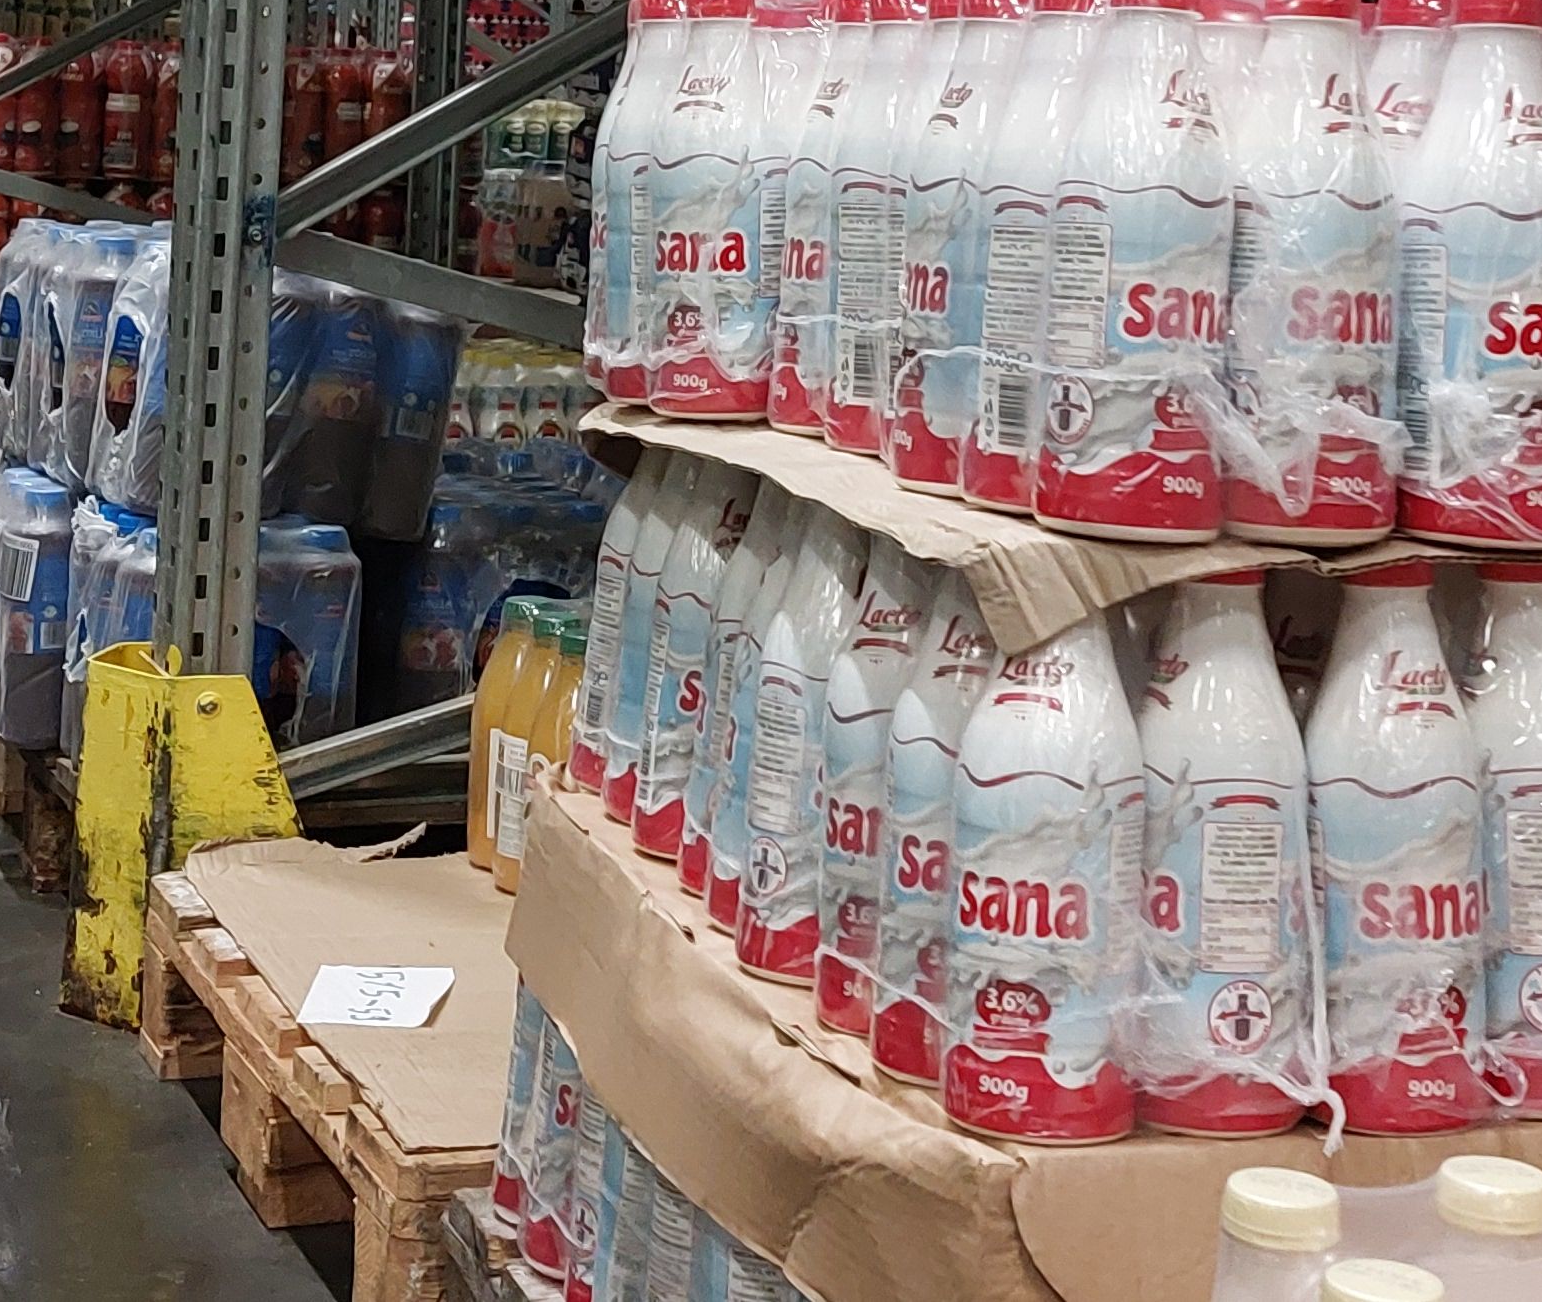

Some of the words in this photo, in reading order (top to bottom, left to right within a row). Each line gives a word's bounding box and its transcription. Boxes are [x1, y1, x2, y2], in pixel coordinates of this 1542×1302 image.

[781, 236, 826, 281] na
[905, 261, 950, 313] na
[672, 372, 708, 391] 900g
[1162, 476, 1205, 500] 900g
[1329, 475, 1373, 497] 900g
[826, 797, 883, 858] sa
[898, 834, 950, 891] sa
[845, 902, 873, 926] 3.6
[959, 869, 1089, 941] sana
[984, 986, 1041, 1015] 3.6%
[978, 1073, 1030, 1105] 900g
[1406, 1077, 1456, 1101] 900g
